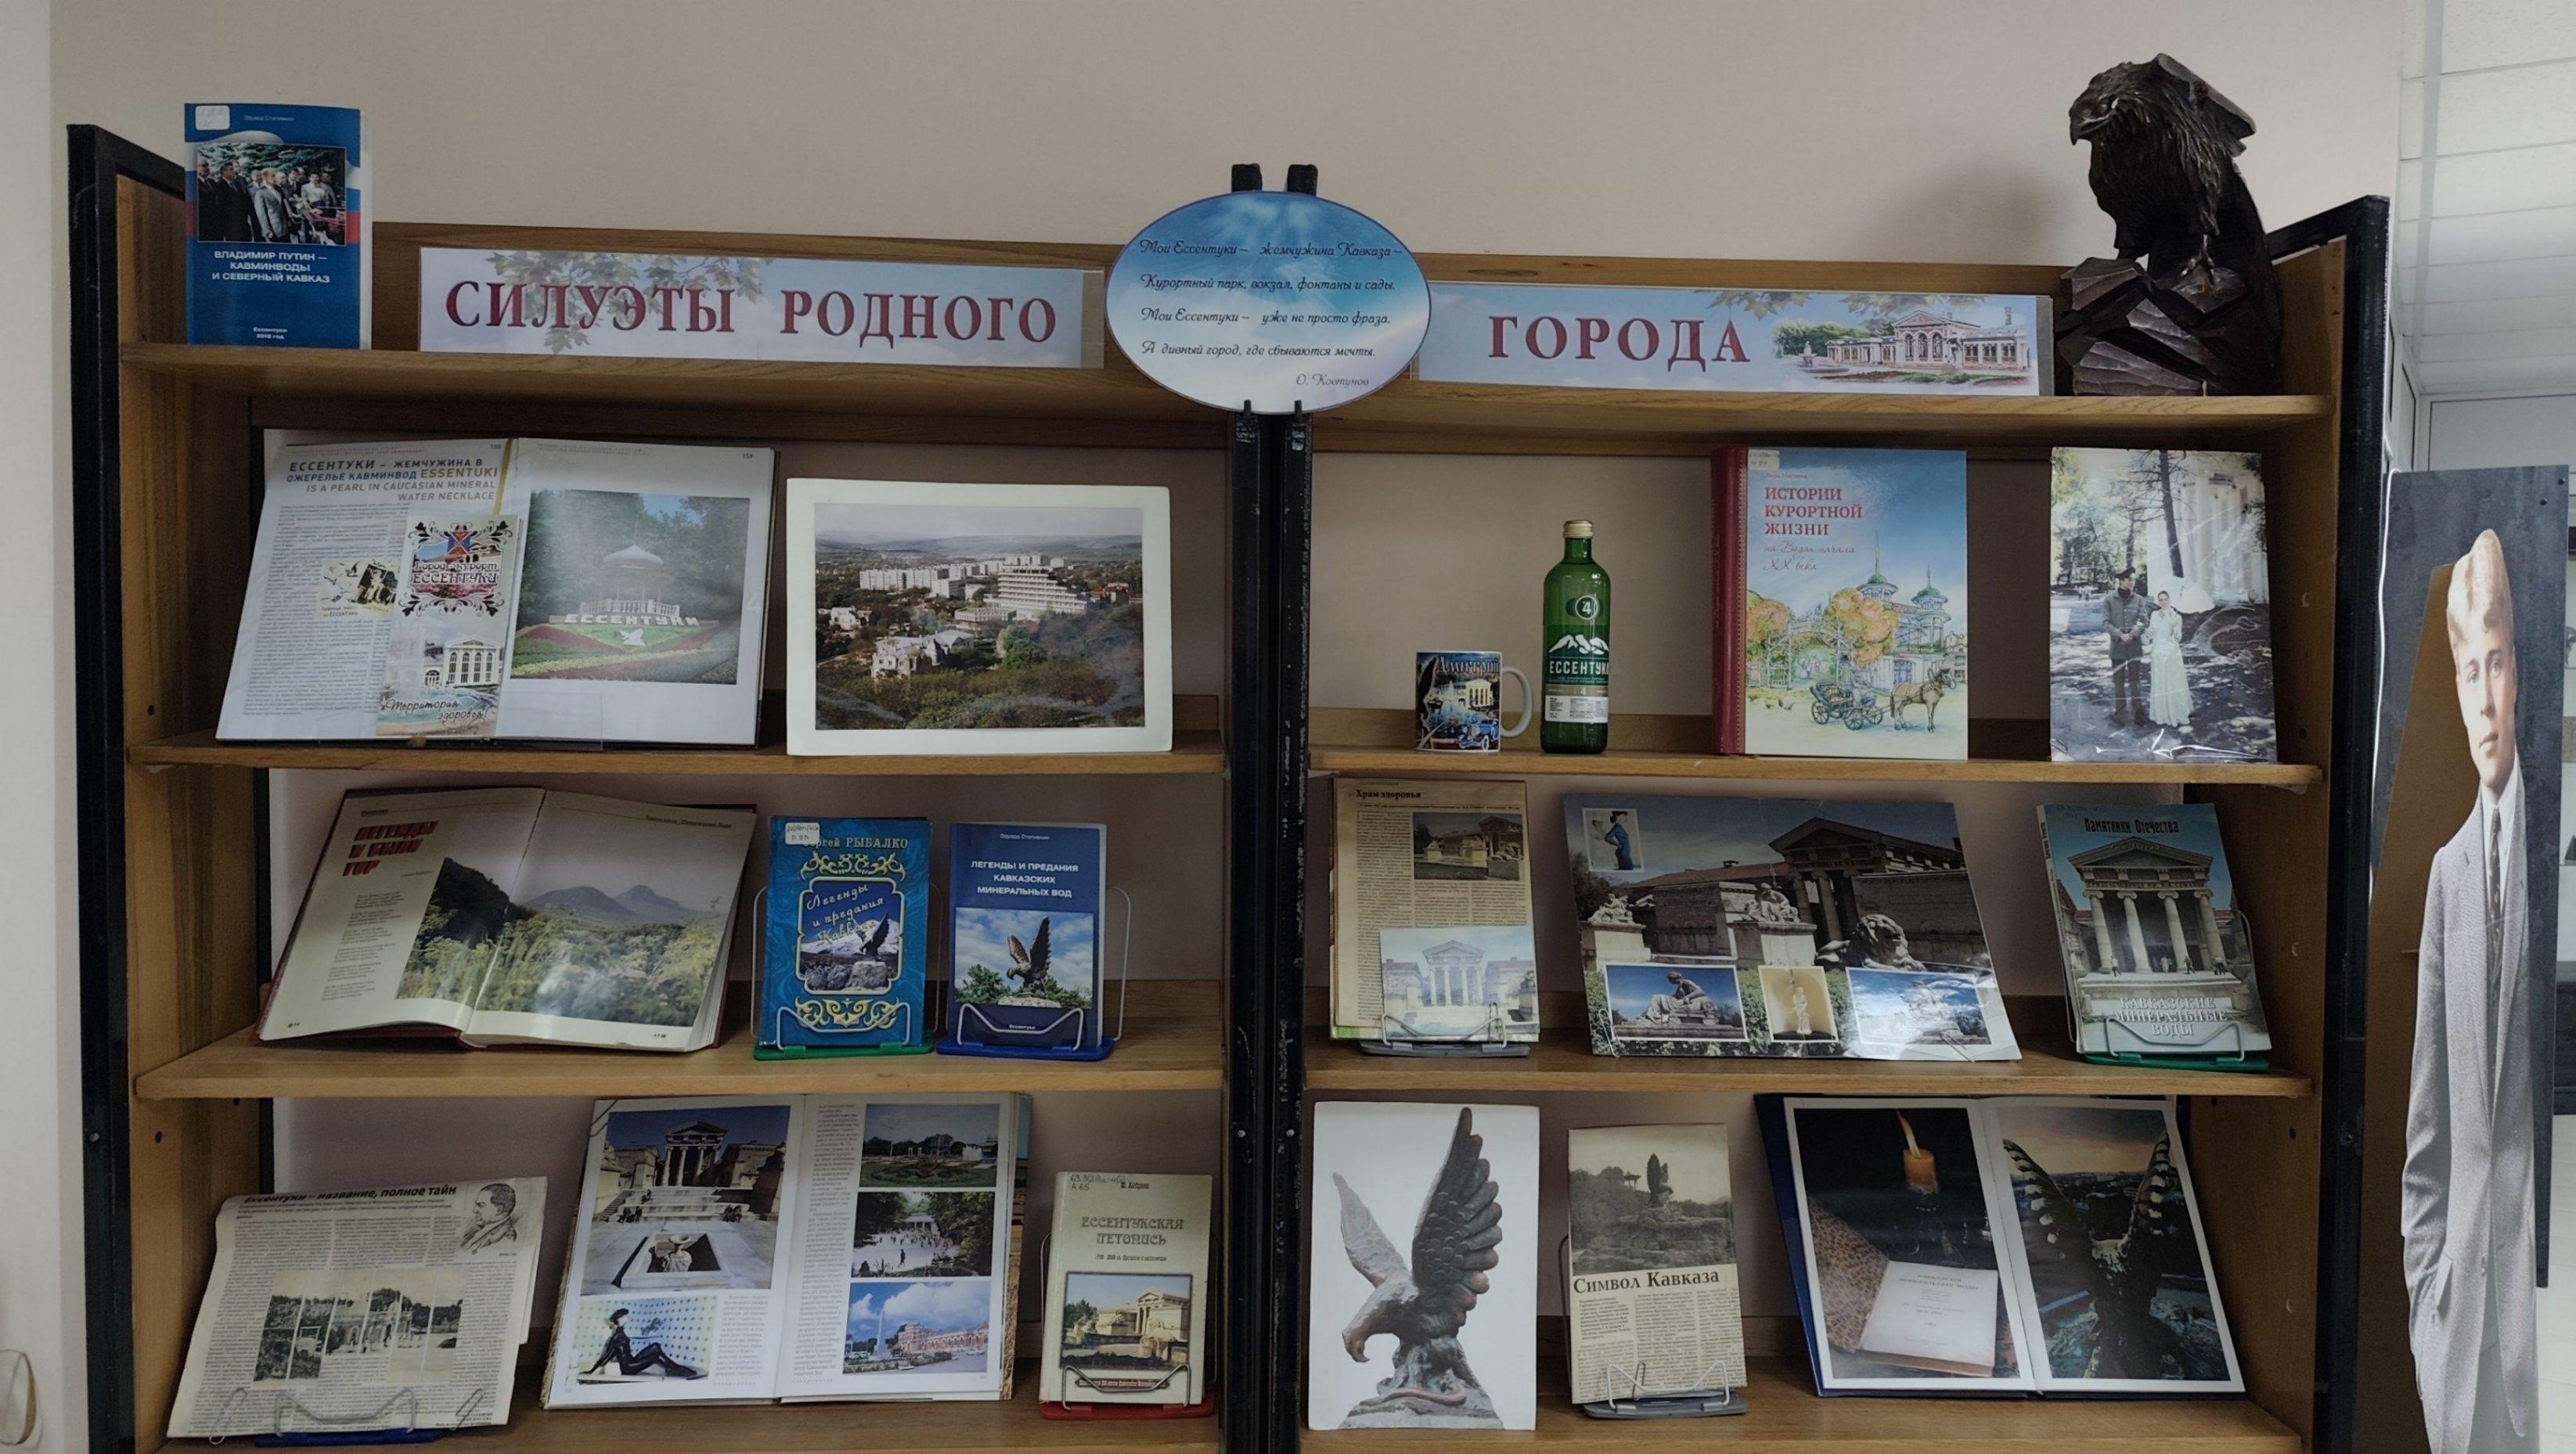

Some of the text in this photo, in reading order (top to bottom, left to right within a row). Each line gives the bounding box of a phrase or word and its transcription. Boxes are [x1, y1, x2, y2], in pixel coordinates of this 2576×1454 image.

[1140, 239, 1170, 254] Мои
[1174, 240, 1237, 257] Ессентуки
[1259, 243, 1334, 258] жемчужина
[1338, 243, 1390, 259] Кавказа
[214, 251, 276, 260] ВЛАДИМИР
[279, 252, 315, 261] ПУТИН
[230, 262, 310, 272] КАВМИНВОДЫ
[222, 272, 283, 282] СЕВЕРНЫЙ
[286, 275, 330, 283] КАВКАЗ
[1140, 274, 1213, 291] Курортный
[1217, 280, 1246, 291] парк,
[1251, 280, 1292, 292] вокзал,
[1297, 277, 1352, 293] фонтаны
[1365, 279, 1395, 290] сады.
[446, 281, 1056, 349] СИЛУЭТЫ РОДНОГО
[1141, 308, 1172, 322] Мои
[1175, 308, 1238, 325] Ессентуки
[1262, 310, 1288, 326] уже
[1307, 315, 1348, 326] просто
[1352, 311, 1390, 326] фраза.
[1142, 340, 1156, 353] А
[1162, 343, 1202, 354] дивный
[1206, 344, 1241, 358] город,
[1246, 345, 1264, 355] где
[1268, 345, 1331, 356] сбываются
[1489, 315, 1750, 372] ГОРОДА
[1296, 373, 1308, 386] О.
[290, 460, 375, 471] ЕССЕНТУКИ
[394, 459, 470, 468] ЖЕМЧУЖИНА
[286, 468, 497, 482] ОЖЕРЕЛЬЕ КАВМИНВОД ESSENTUKI
[447, 480, 495, 489] MINERAL
[1765, 488, 1842, 500] ИСТОРИИ
[1765, 504, 1862, 518] КУРОРТНОЙ
[1764, 523, 1828, 535] ЖИЗНИ
[413, 573, 496, 583] ЕССЕНТУКИ
[1582, 601, 1592, 614] 4
[564, 614, 700, 626] ЕССЕНТУКИ
[1356, 790, 1421, 800] Храм здоровья
[2084, 818, 2179, 834] Памятники Отечества
[845, 837, 908, 849] РЫБАЛКО
[971, 861, 1016, 870] ЛЕГЕНДЫ
[1029, 863, 1079, 872] ПРЕДАНИЯ
[993, 874, 1056, 884] КАВКАЗСКИХ
[806, 884, 869, 910] Легенды
[978, 887, 1072, 898] МИНЕРАЛЬНЫХ ВОД
[824, 897, 884, 927] предания
[2120, 997, 2216, 1010] КАВКАЗСКИЕ
[2114, 1010, 2228, 1022] МИНЕРАЛЬНЫЕ
[2153, 1024, 2194, 1038] ВОДЫ
[244, 1194, 306, 1204] Ессентуки
[317, 1189, 377, 1200] название,
[380, 1187, 424, 1197] полное
[428, 1184, 457, 1196] тайн
[1081, 1217, 1184, 1229] ЕССЕНТУКСКАЯ
[1097, 1233, 1166, 1245] ЛЕТОПИСЬ
[1573, 1271, 1720, 1294] Символ Кавказа
